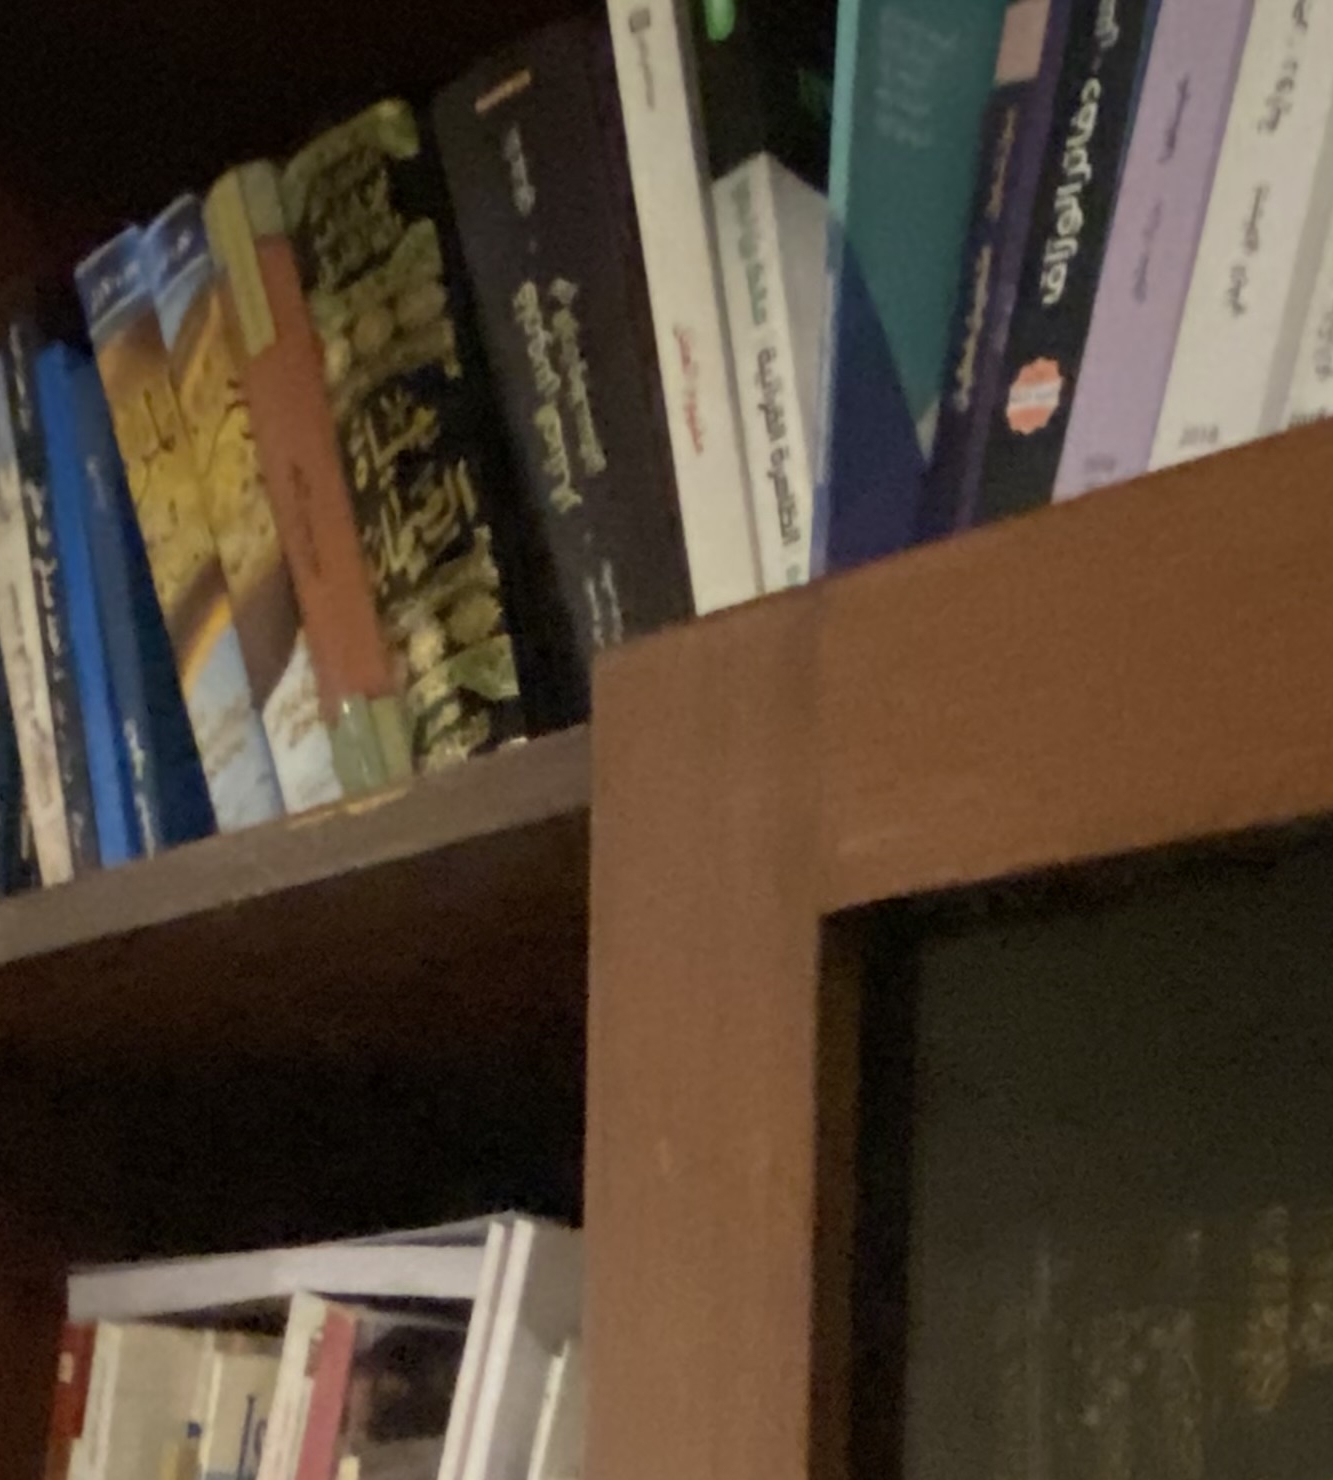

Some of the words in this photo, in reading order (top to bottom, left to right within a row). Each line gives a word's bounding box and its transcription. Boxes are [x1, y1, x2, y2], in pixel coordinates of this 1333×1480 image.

[1064, 77, 1102, 182] دفاتر
[1041, 182, 1085, 306] الوراق
[766, 445, 800, 546] الظاهرة
